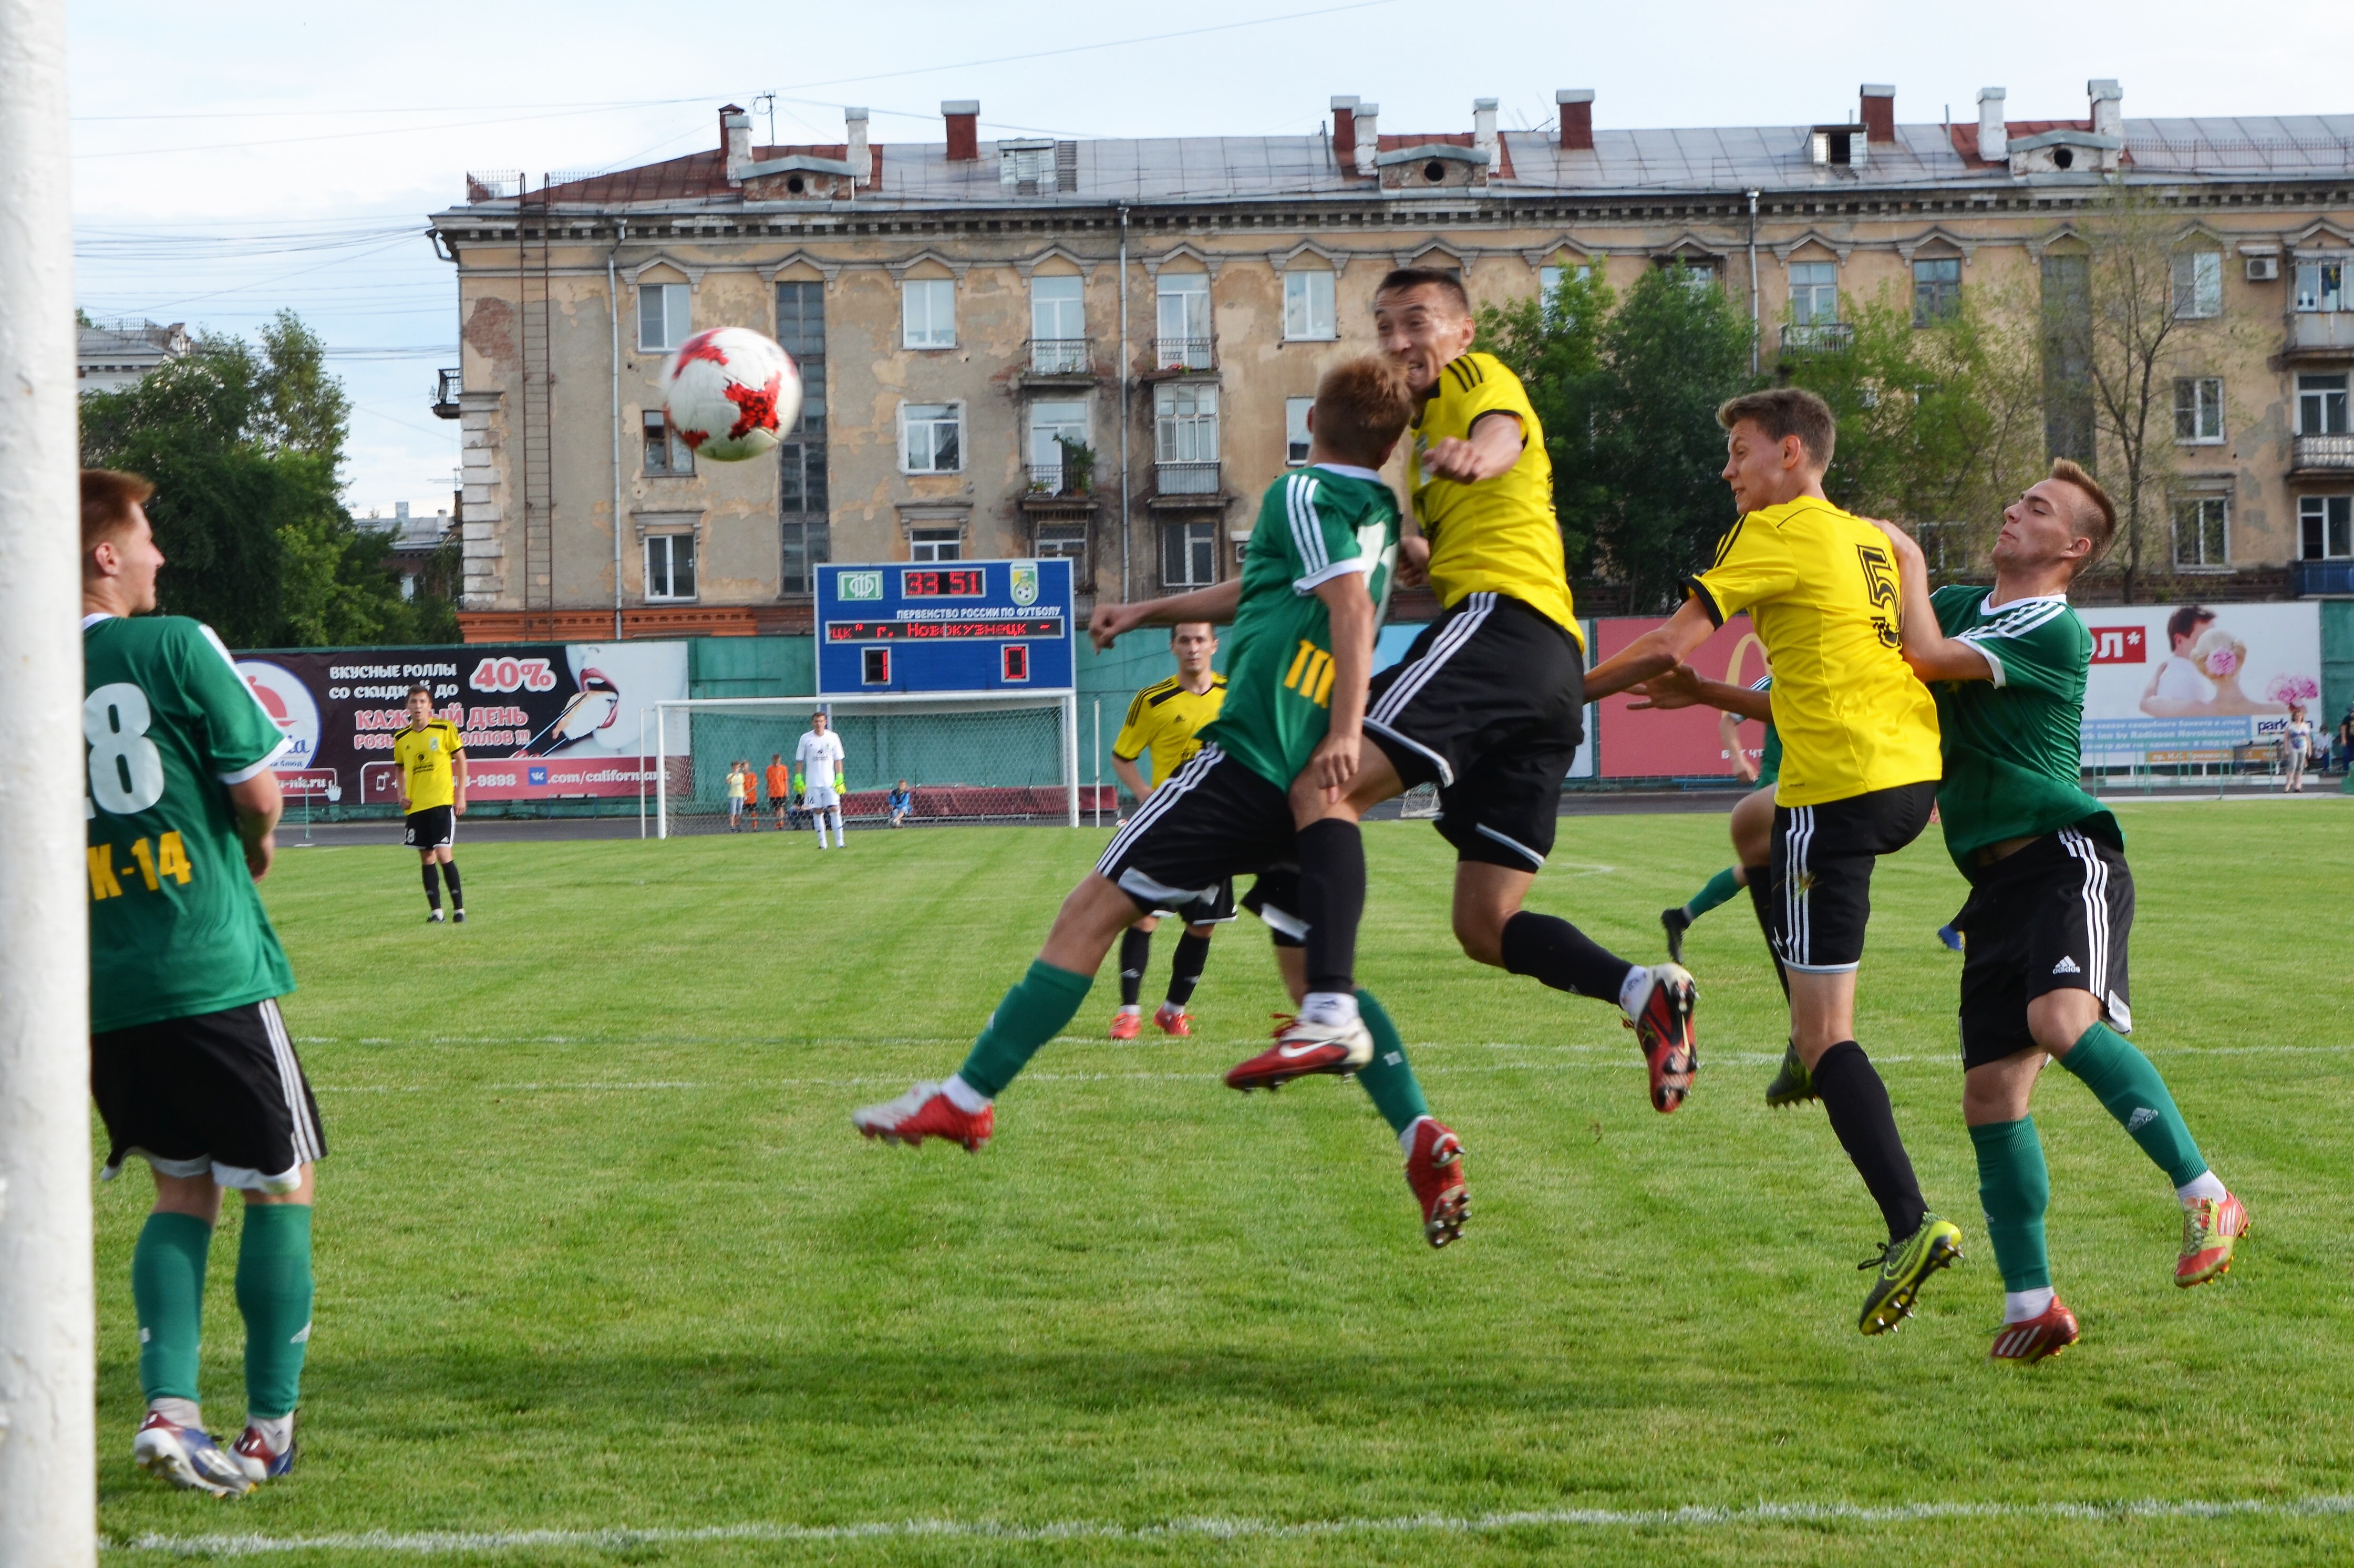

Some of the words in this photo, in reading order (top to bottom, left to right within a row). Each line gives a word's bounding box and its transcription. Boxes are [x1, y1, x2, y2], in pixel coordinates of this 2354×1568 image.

[906, 572, 939, 595] 33
[949, 571, 980, 595] 51
[1855, 543, 1902, 649] 5
[897, 609, 959, 620] ПЕРВЕНСТВО
[961, 607, 999, 618] РОССИИ
[1001, 607, 1015, 617] ПО
[1017, 606, 1061, 616] ФУТБОЛУ
[329, 665, 401, 680] ВКУСНЫЕ
[403, 663, 458, 678] РОЛЛЫ
[882, 651, 887, 682] 1
[1005, 647, 1026, 678] 0
[472, 658, 555, 691] 40%
[354, 680, 431, 700] СКИДКЙ
[355, 703, 464, 731] КАЖЫЙ
[467, 706, 529, 731] ДЕНЬ
[459, 730, 514, 747] ОЛЛОВ
[1721, 749, 1746, 759] ВТ
[2052, 966, 2081, 975] adidas
